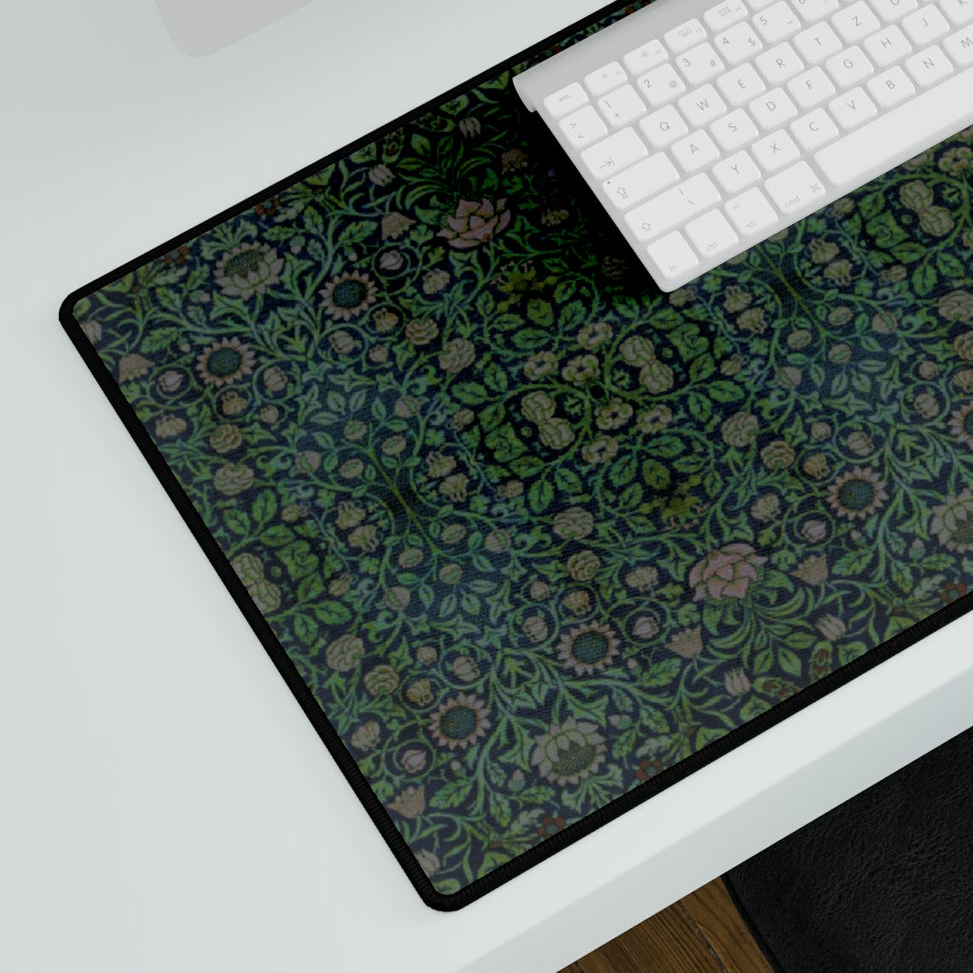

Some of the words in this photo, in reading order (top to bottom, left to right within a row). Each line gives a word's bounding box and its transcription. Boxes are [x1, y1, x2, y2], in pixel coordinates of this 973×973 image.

[759, 16, 768, 25] 5
[851, 16, 862, 27] Z
[922, 17, 928, 27] J
[722, 37, 730, 45] 4
[814, 37, 822, 46] T
[880, 37, 892, 49] H
[961, 37, 973, 48] M
[682, 58, 691, 67] 3
[775, 58, 786, 68] R
[843, 59, 854, 69] G
[923, 58, 935, 69] N
[643, 79, 652, 88] 2
[737, 79, 746, 89] E
[805, 79, 812, 90] F
[885, 80, 895, 90] B
[604, 101, 612, 109] 1
[696, 99, 709, 111] W
[766, 101, 776, 112] D
[846, 100, 856, 110] V
[659, 121, 671, 131] Q
[728, 122, 737, 132] S
[809, 121, 819, 132] C
[690, 144, 700, 154] A
[769, 143, 781, 154] X
[730, 164, 739, 174] Y
[784, 195, 800, 208] cmd
